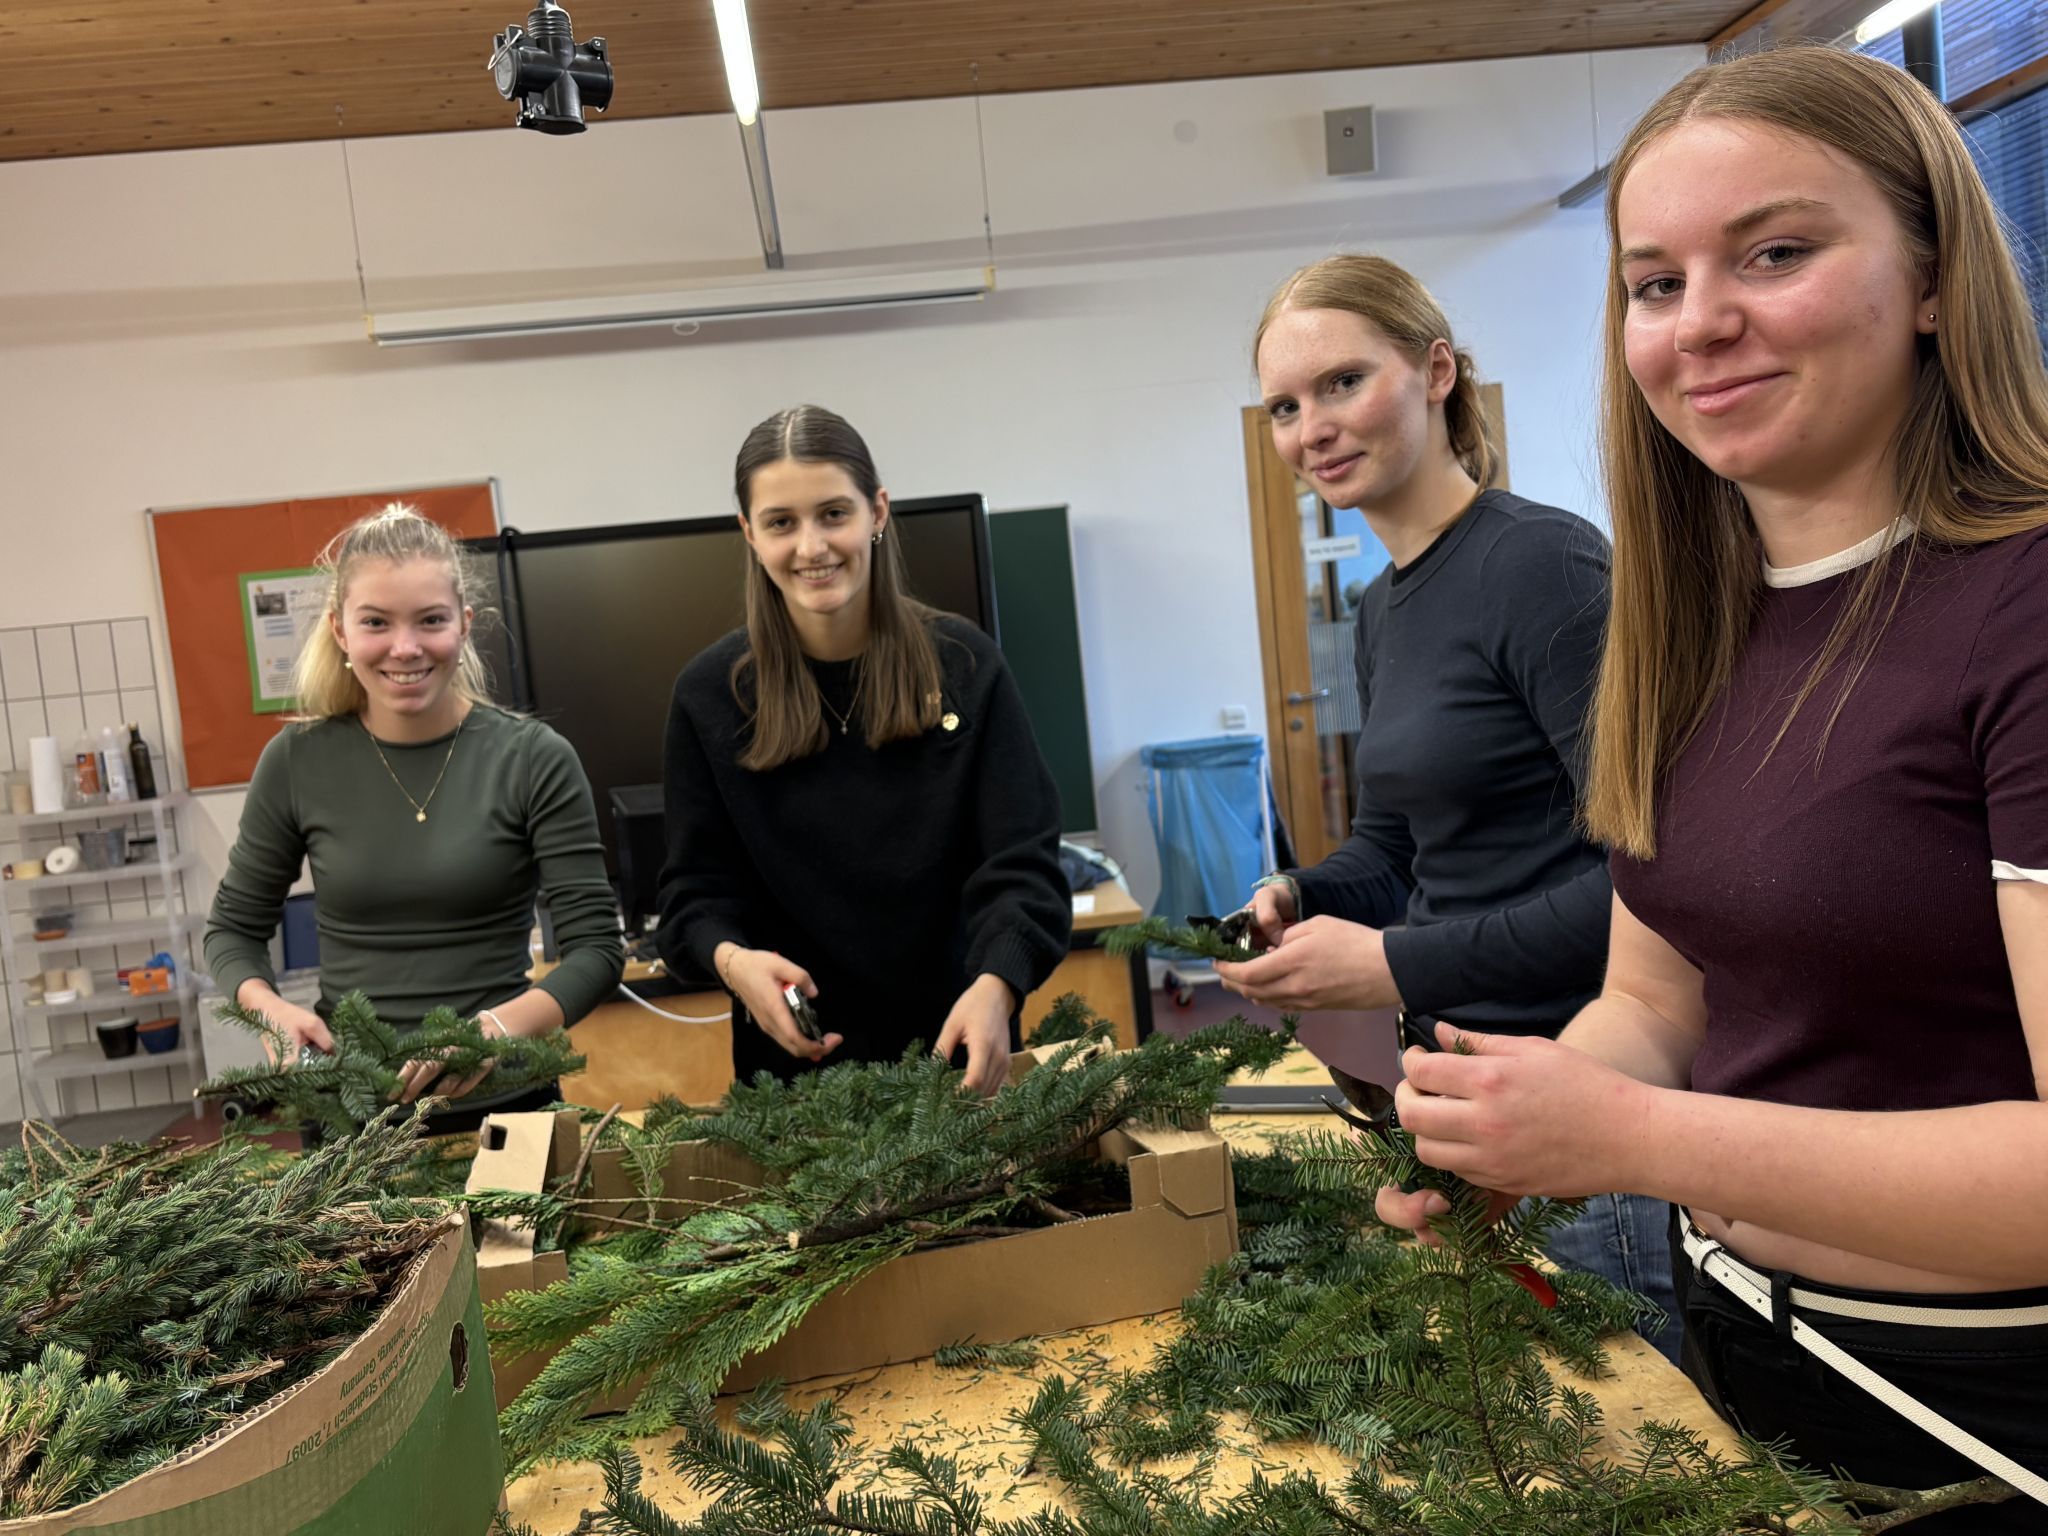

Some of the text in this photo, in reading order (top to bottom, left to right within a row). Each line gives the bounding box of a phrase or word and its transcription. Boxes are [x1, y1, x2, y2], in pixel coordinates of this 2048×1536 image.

[340, 1358, 377, 1400] Germany
[334, 1379, 378, 1429] Stadtdeich
[285, 1432, 322, 1466] 20097
[323, 1423, 331, 1438] 7,
